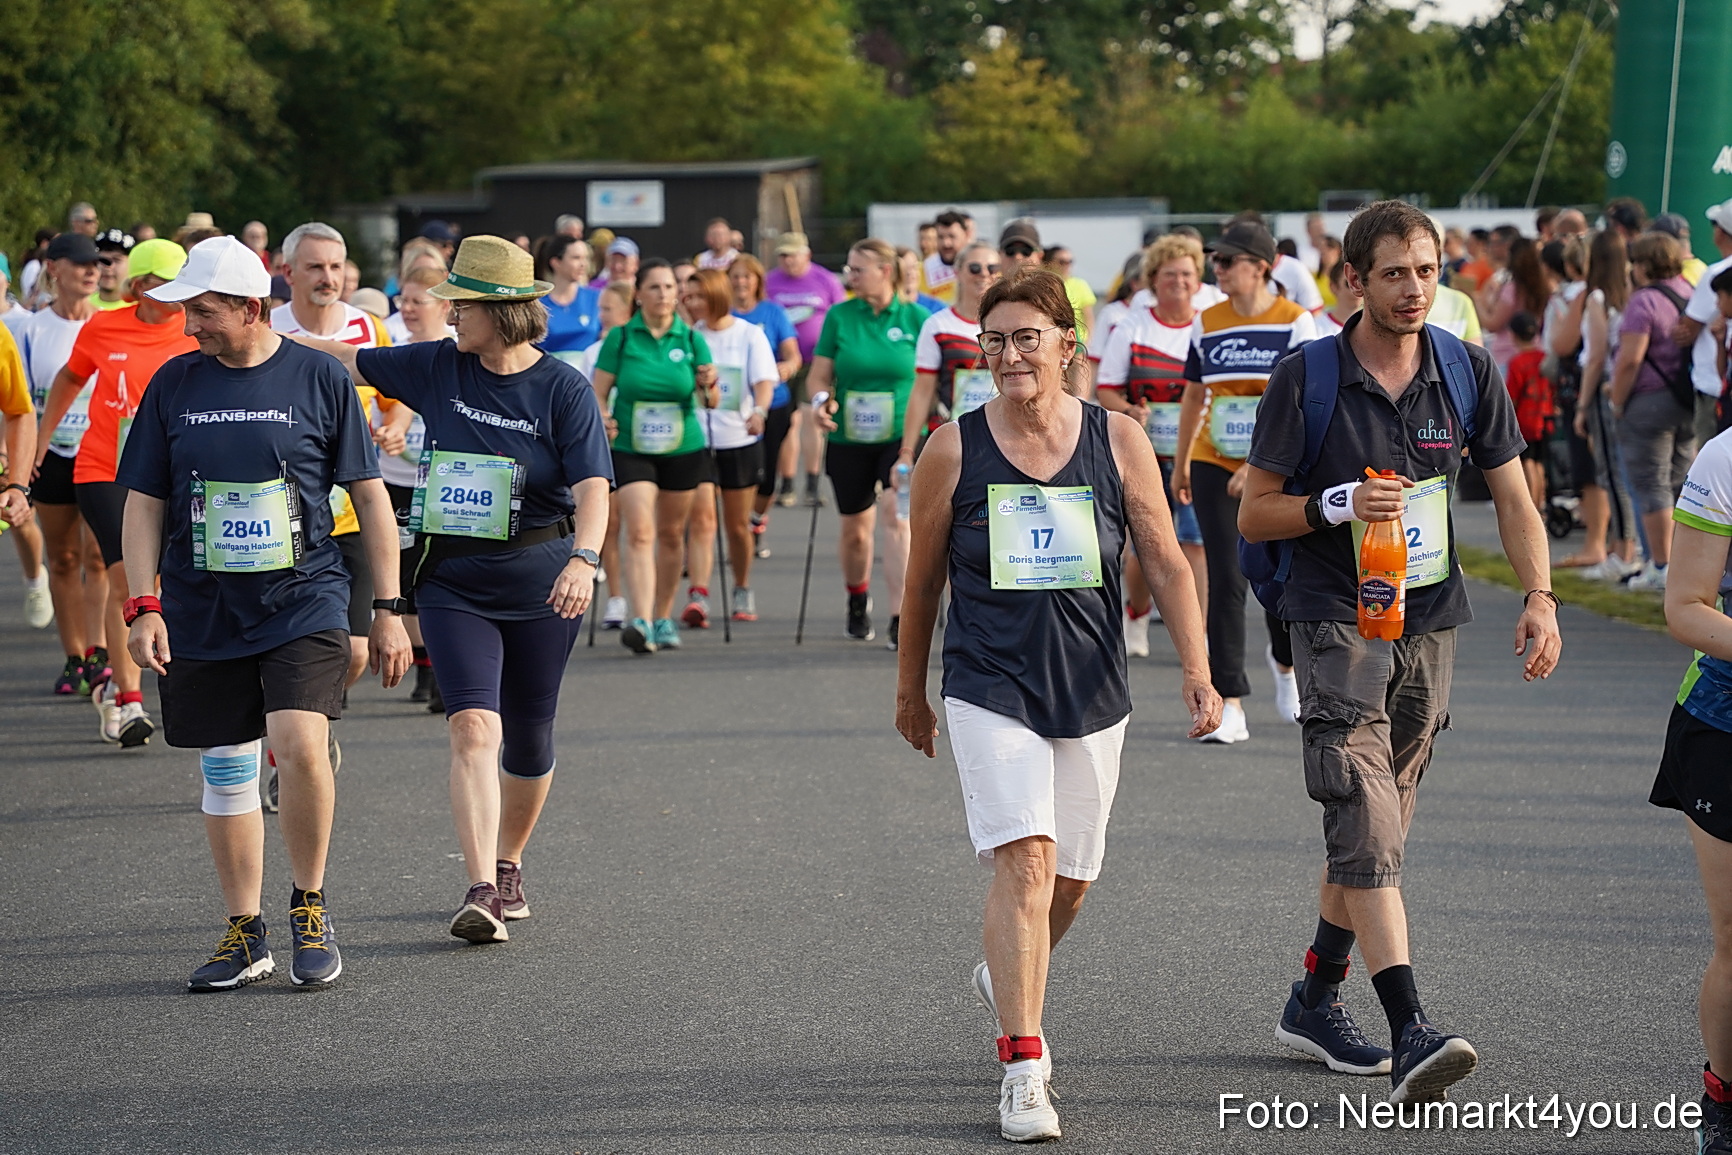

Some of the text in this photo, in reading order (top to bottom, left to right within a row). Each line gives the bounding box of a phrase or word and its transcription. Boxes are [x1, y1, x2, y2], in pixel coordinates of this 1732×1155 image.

[1712, 145, 1732, 174] A
[495, 287, 511, 295] AOK
[1220, 347, 1279, 361] Fischer
[189, 410, 288, 425] TRANSpofix
[456, 402, 534, 432] TRANSpofix
[1417, 418, 1453, 440] aha!
[1417, 441, 1453, 450] Tagespflege
[440, 486, 493, 507] 2848
[442, 507, 491, 518] Susi Schraufl
[1015, 503, 1047, 512] Firmenlauf
[222, 519, 271, 538] 2841
[1030, 527, 1054, 550] 17
[214, 541, 250, 552] Wolfgang
[1008, 554, 1083, 566] Doris Bergmann
